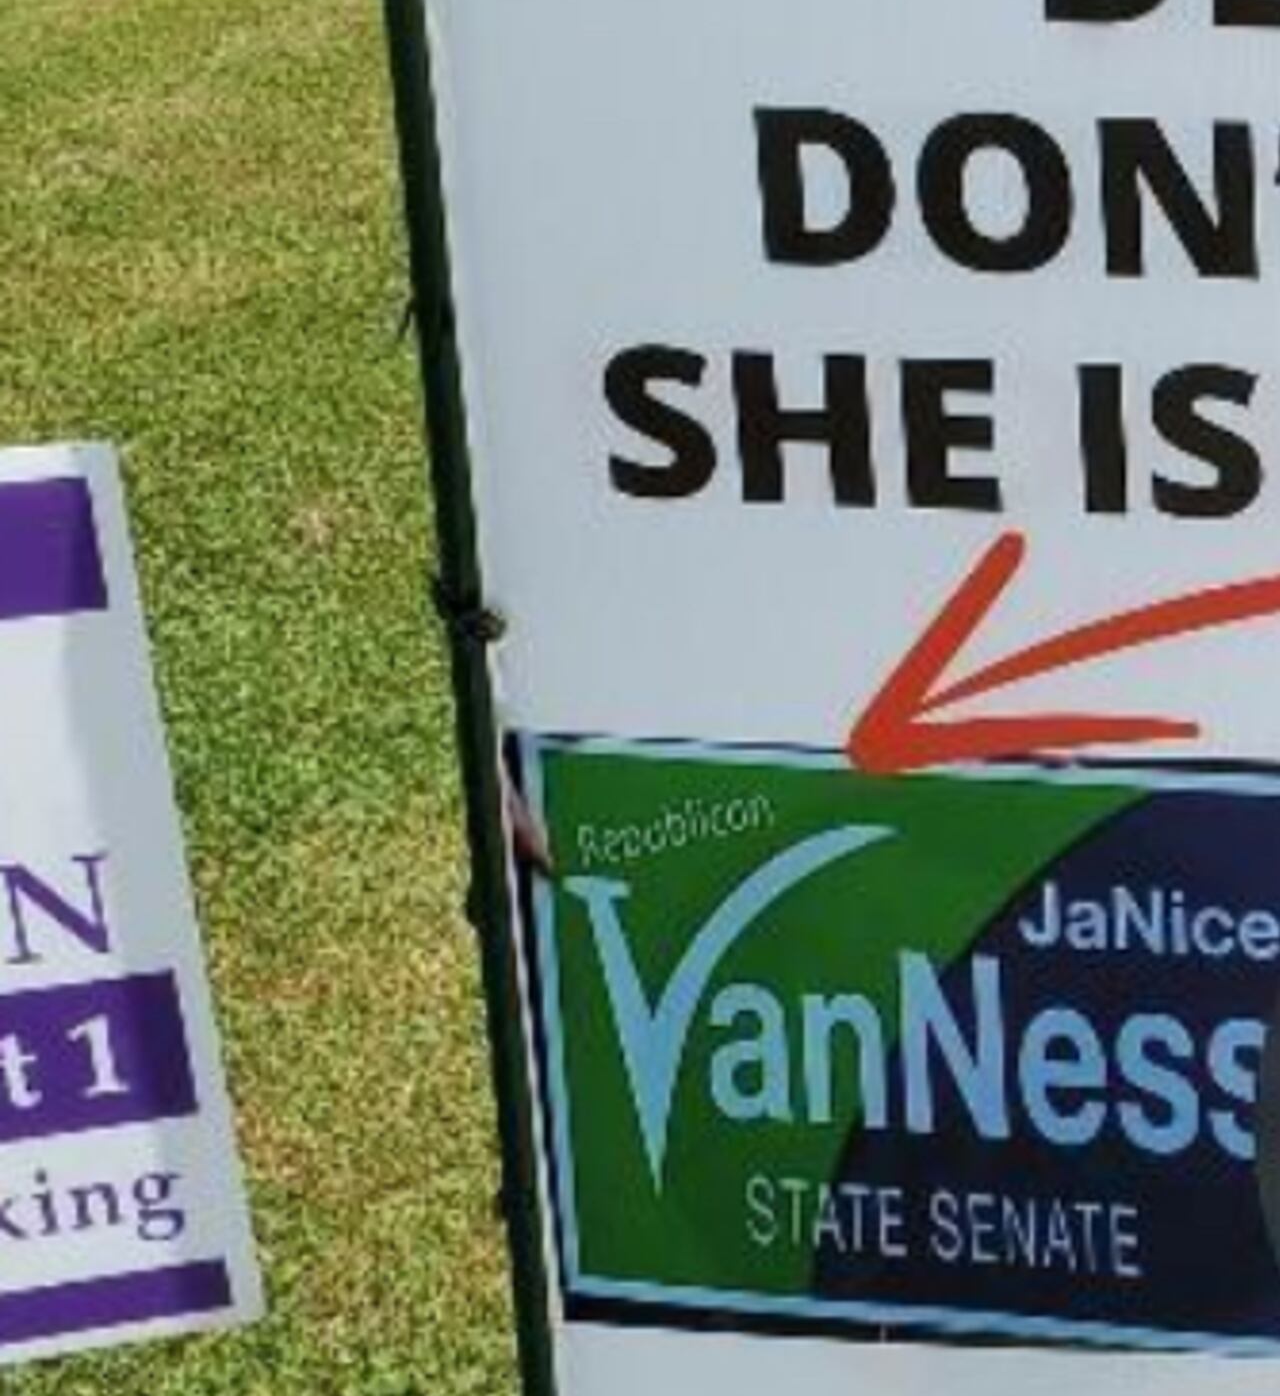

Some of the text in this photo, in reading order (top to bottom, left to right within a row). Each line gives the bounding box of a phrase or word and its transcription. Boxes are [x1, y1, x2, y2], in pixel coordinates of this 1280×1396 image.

[603, 342, 1004, 515] SHE
[1076, 362, 1264, 520] IS
[67, 1014, 130, 1098] 1
[565, 823, 1268, 1194] VanNess
[744, 1174, 1145, 1278] STATE SENATE
